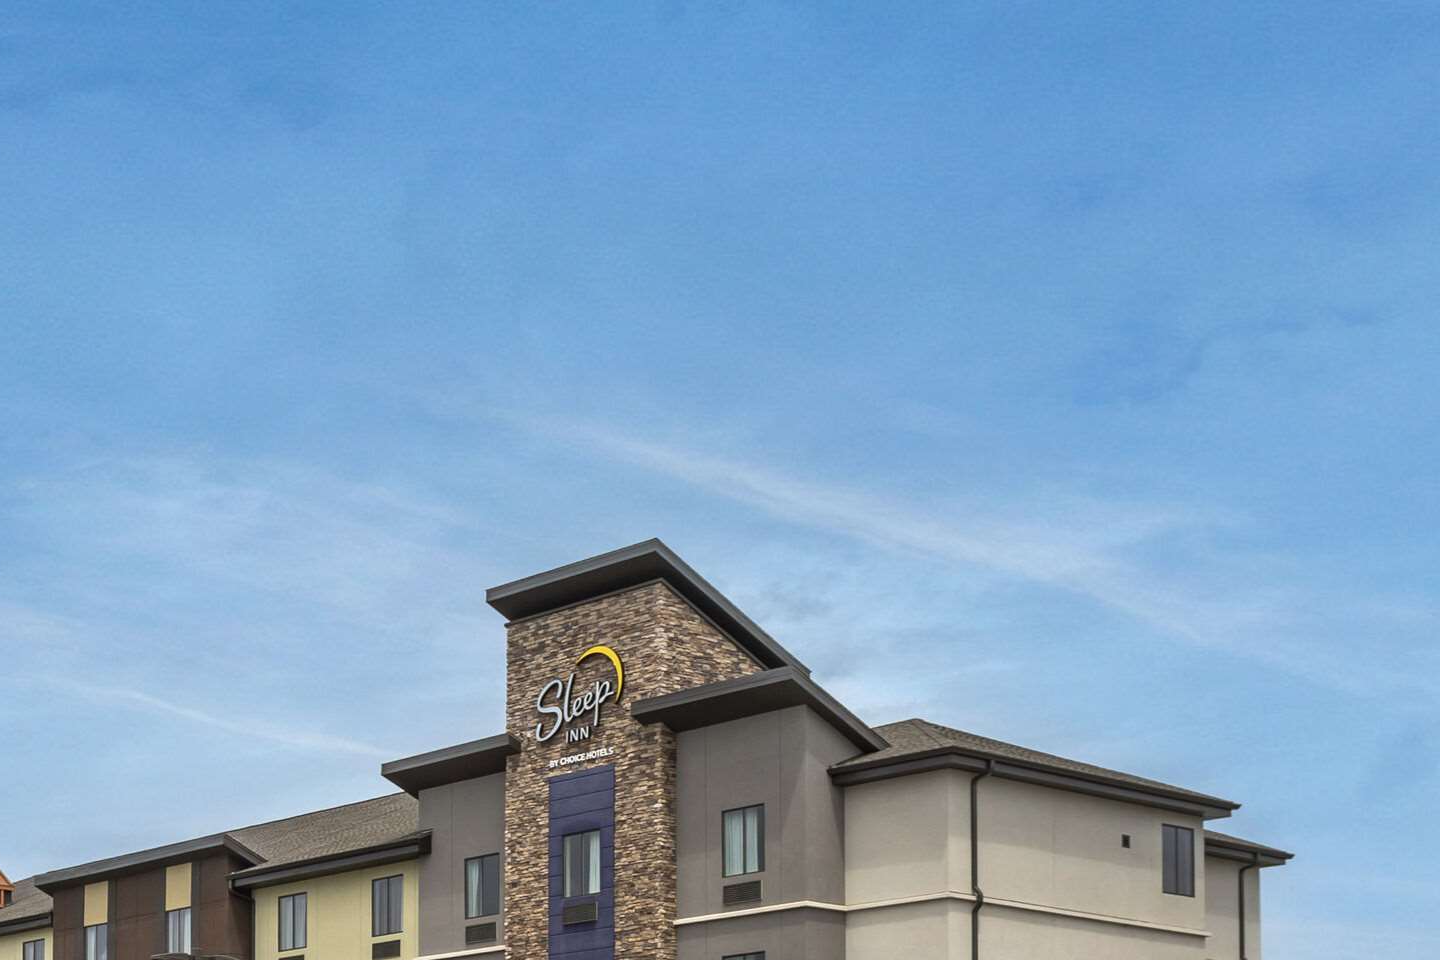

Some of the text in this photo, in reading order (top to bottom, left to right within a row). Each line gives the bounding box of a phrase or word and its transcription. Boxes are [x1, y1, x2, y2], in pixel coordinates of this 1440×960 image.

[536, 673, 614, 742] Sleep
[565, 726, 589, 744] INN
[549, 747, 614, 768] BY CHOICE HOTELS
